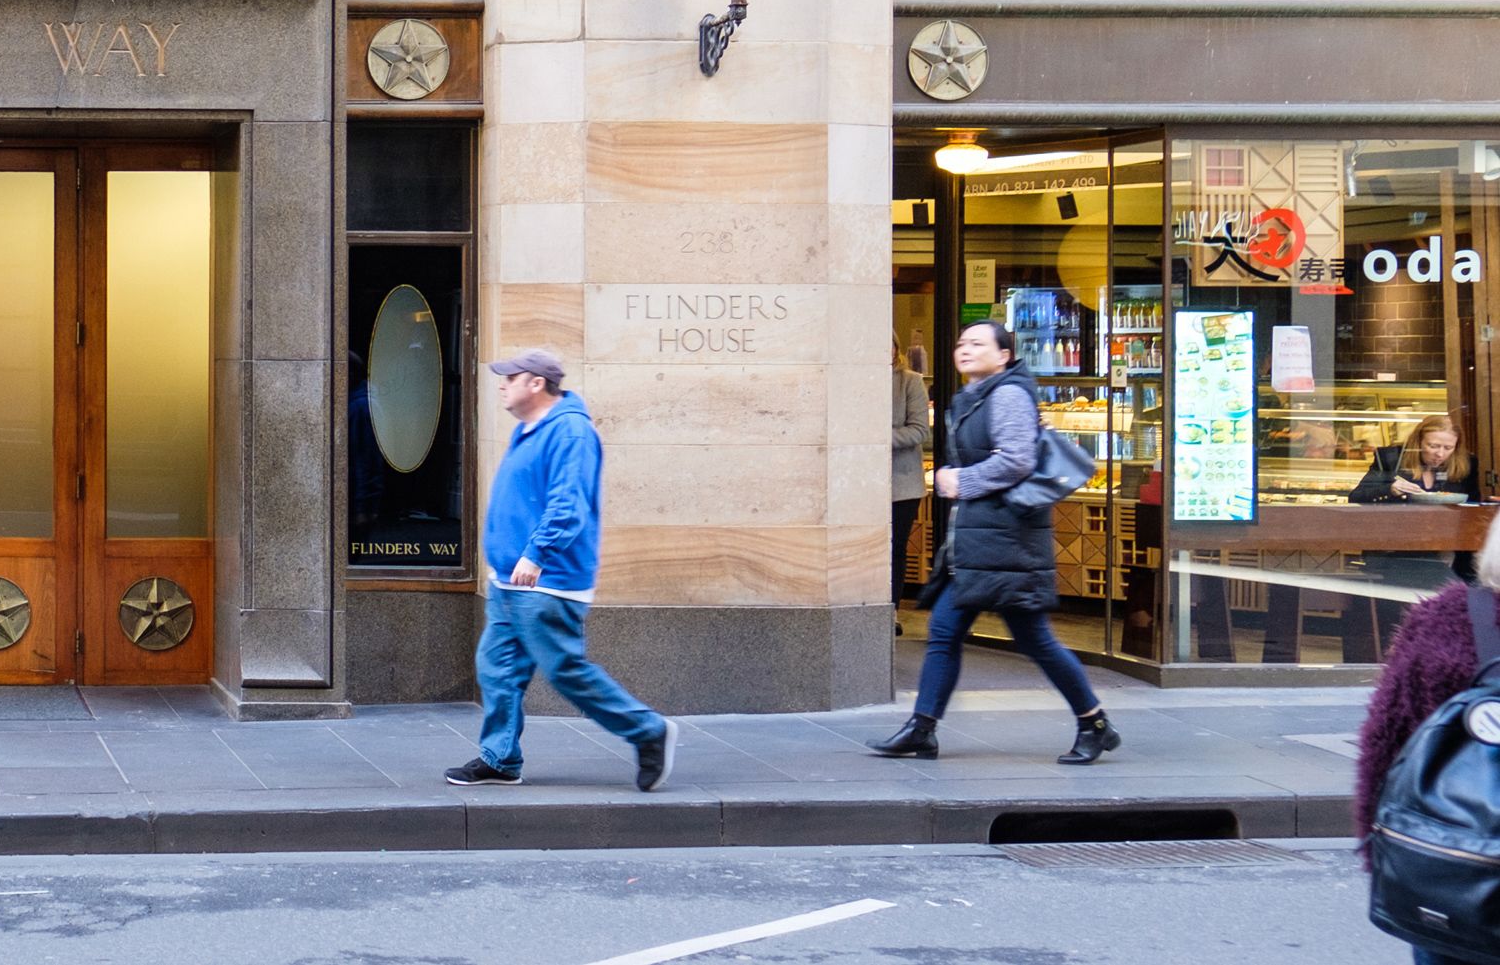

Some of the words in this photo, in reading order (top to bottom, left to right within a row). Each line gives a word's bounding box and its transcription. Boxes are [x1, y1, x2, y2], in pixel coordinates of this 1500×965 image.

[43, 21, 184, 77] WAY
[964, 183, 988, 195] ABN
[994, 182, 1009, 194] 40
[679, 231, 735, 254] 238
[1362, 235, 1482, 283] oda
[626, 294, 788, 320] FLINDERS
[658, 328, 757, 353] HOUSE
[351, 542, 420, 555] FLINDERS
[429, 543, 458, 555] WAY
